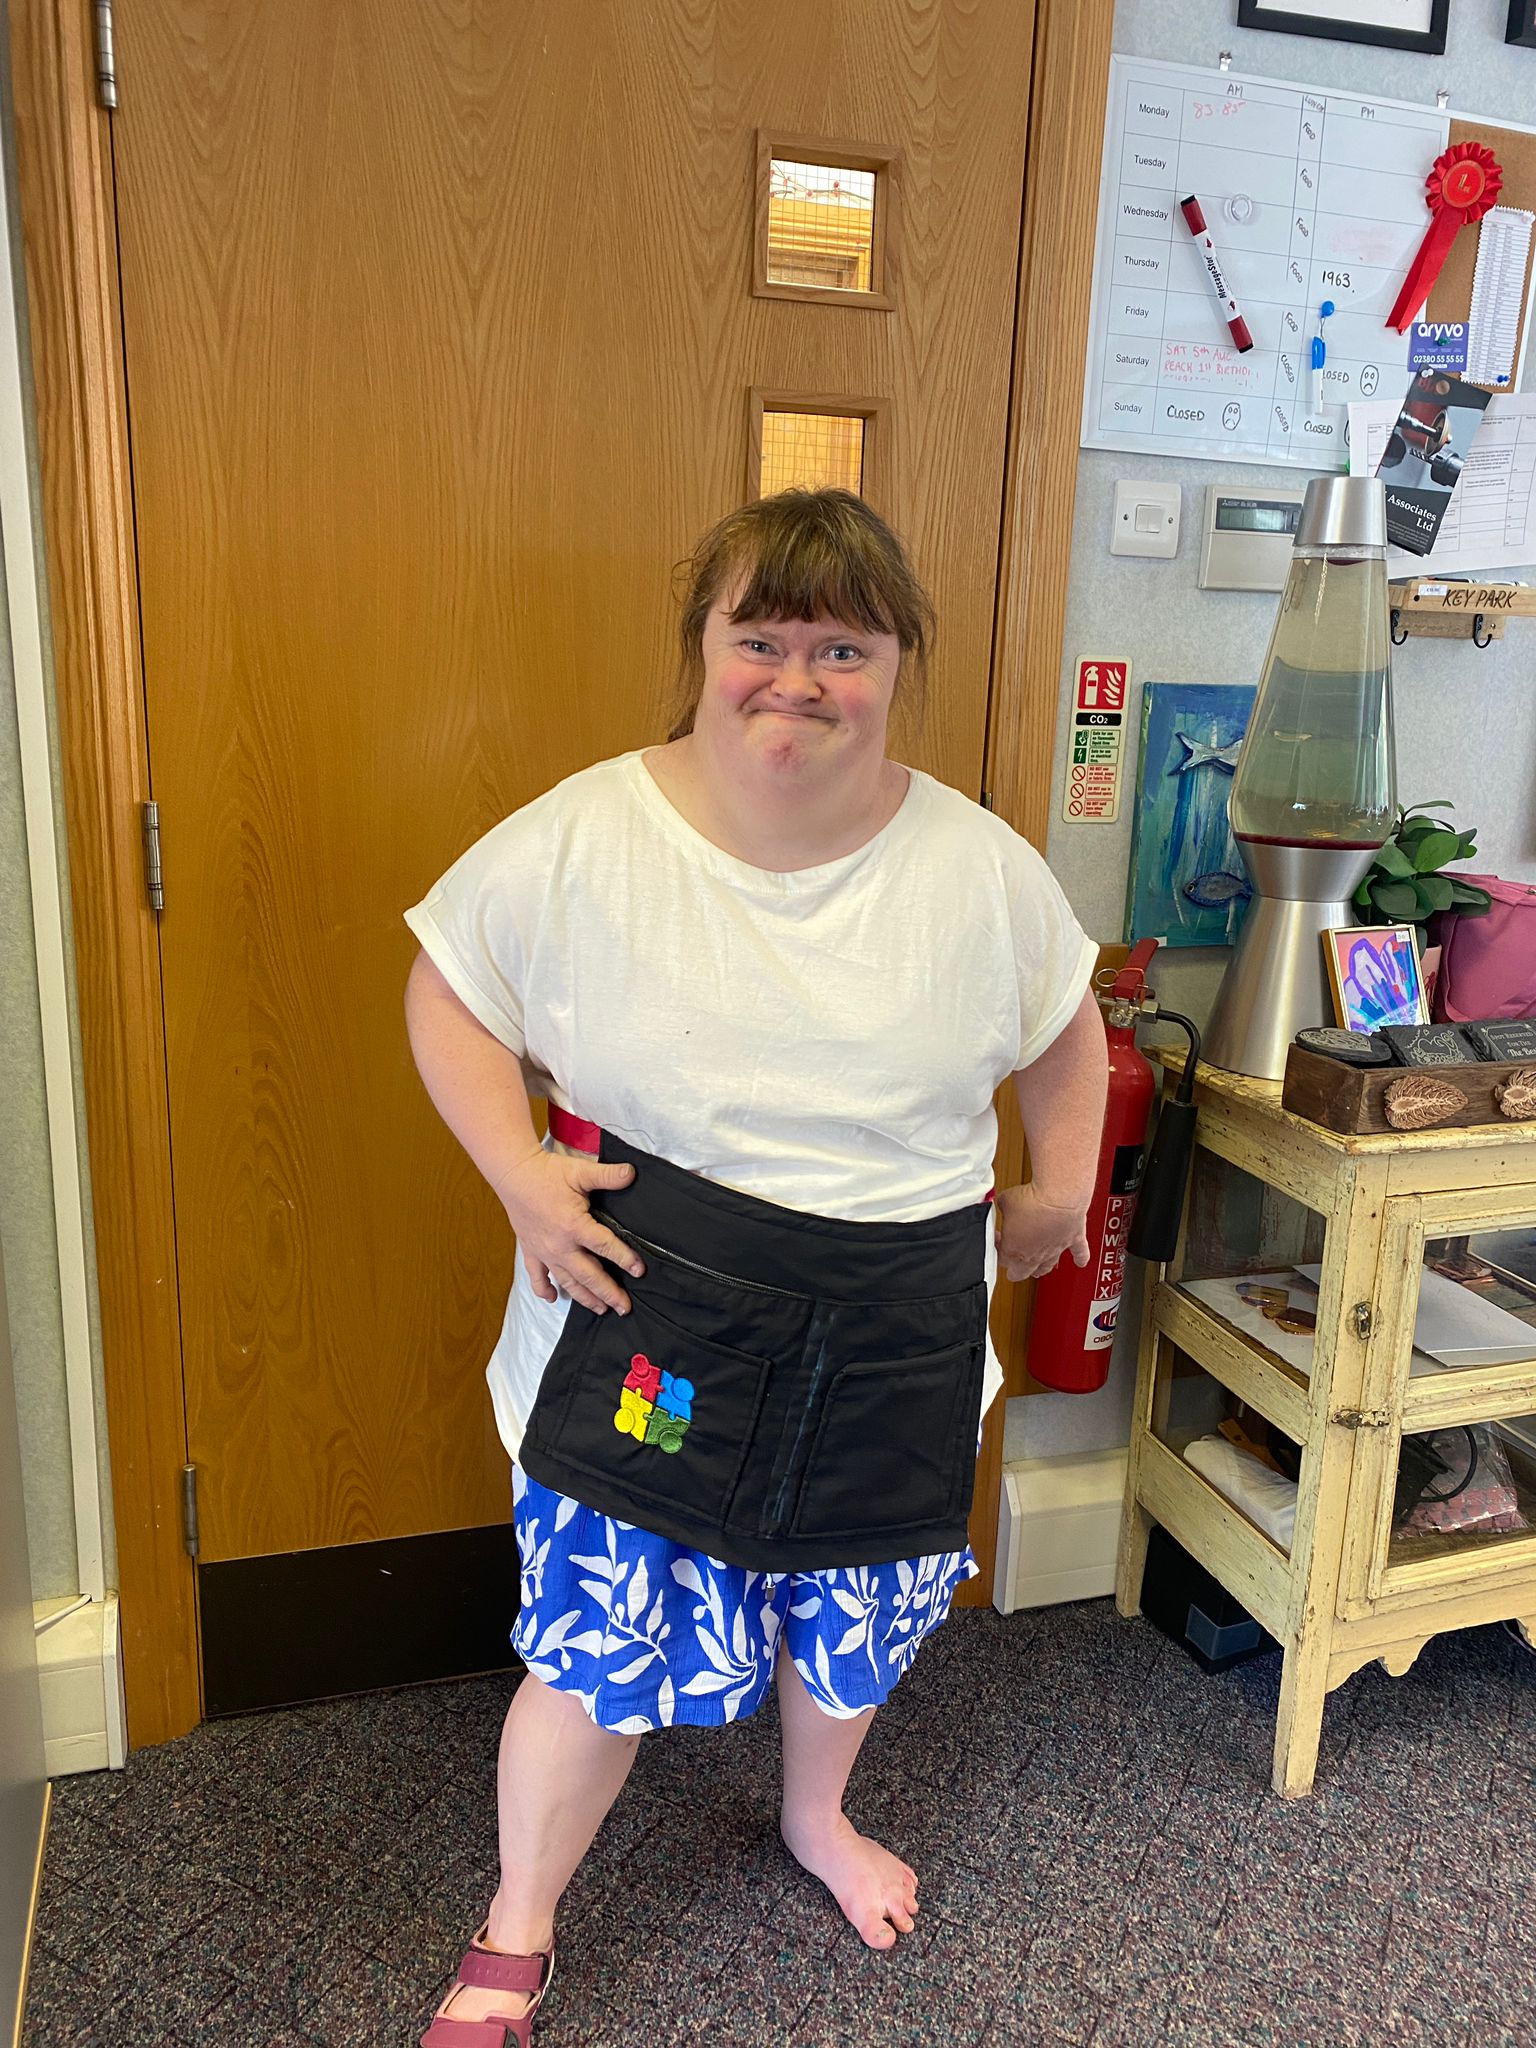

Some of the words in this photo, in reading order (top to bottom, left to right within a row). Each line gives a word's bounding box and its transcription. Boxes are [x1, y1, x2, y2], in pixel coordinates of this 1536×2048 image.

[1226, 83, 1244, 98] AM
[1138, 103, 1170, 118] Monday
[1360, 106, 1375, 119] PM
[1134, 154, 1167, 170] Tuesday
[1123, 205, 1169, 221] Wednesday
[1124, 255, 1160, 270] Thursday
[1125, 305, 1149, 319] Friday
[1418, 323, 1464, 341] aryvo
[1115, 353, 1150, 367] Saturday
[1413, 354, 1436, 363] 02380
[1436, 354, 1445, 363] 55
[1446, 354, 1455, 363] 55
[1455, 354, 1464, 363] 55
[1322, 369, 1350, 383] LOSED
[1114, 401, 1142, 415] Sunday
[1166, 404, 1206, 421] CLOSED
[1303, 420, 1334, 435] CLOSED
[1387, 494, 1437, 522] Associates
[1416, 517, 1434, 532] Ltd
[1442, 589, 1476, 608] KEY
[1475, 589, 1517, 608] PARK
